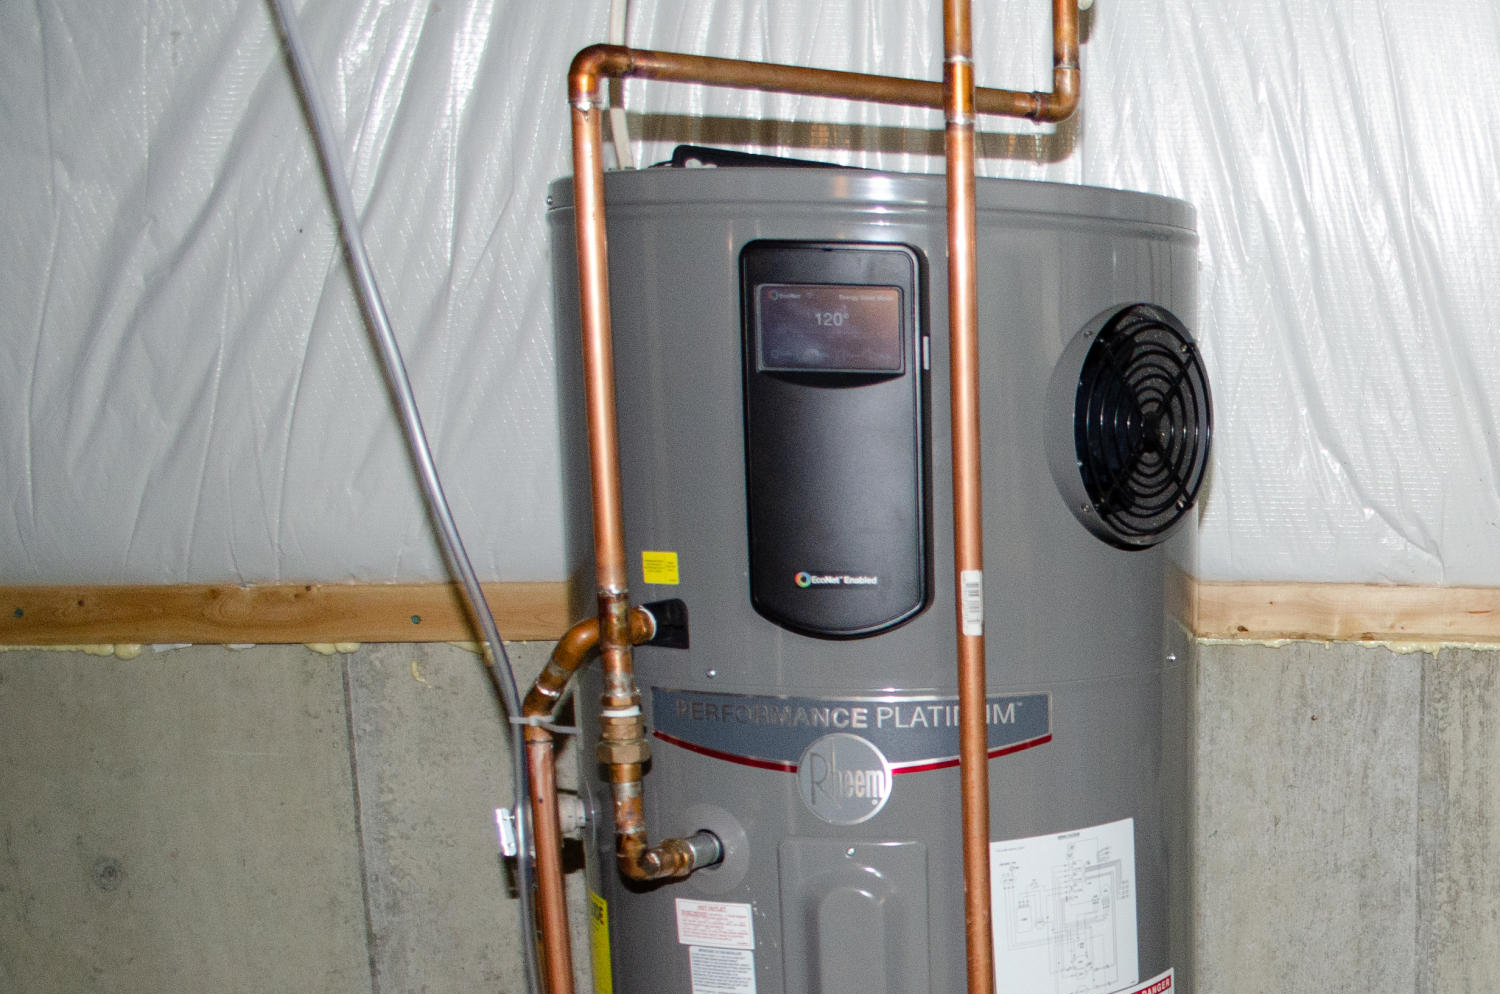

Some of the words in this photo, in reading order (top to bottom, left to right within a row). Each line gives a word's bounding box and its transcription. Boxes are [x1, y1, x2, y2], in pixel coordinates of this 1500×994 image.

[815, 312, 849, 326] 120°
[843, 575, 877, 584] Enabled
[675, 700, 868, 729] PERFORMANCE
[876, 703, 1016, 728] PLATIM
[809, 742, 886, 806] Rheem
